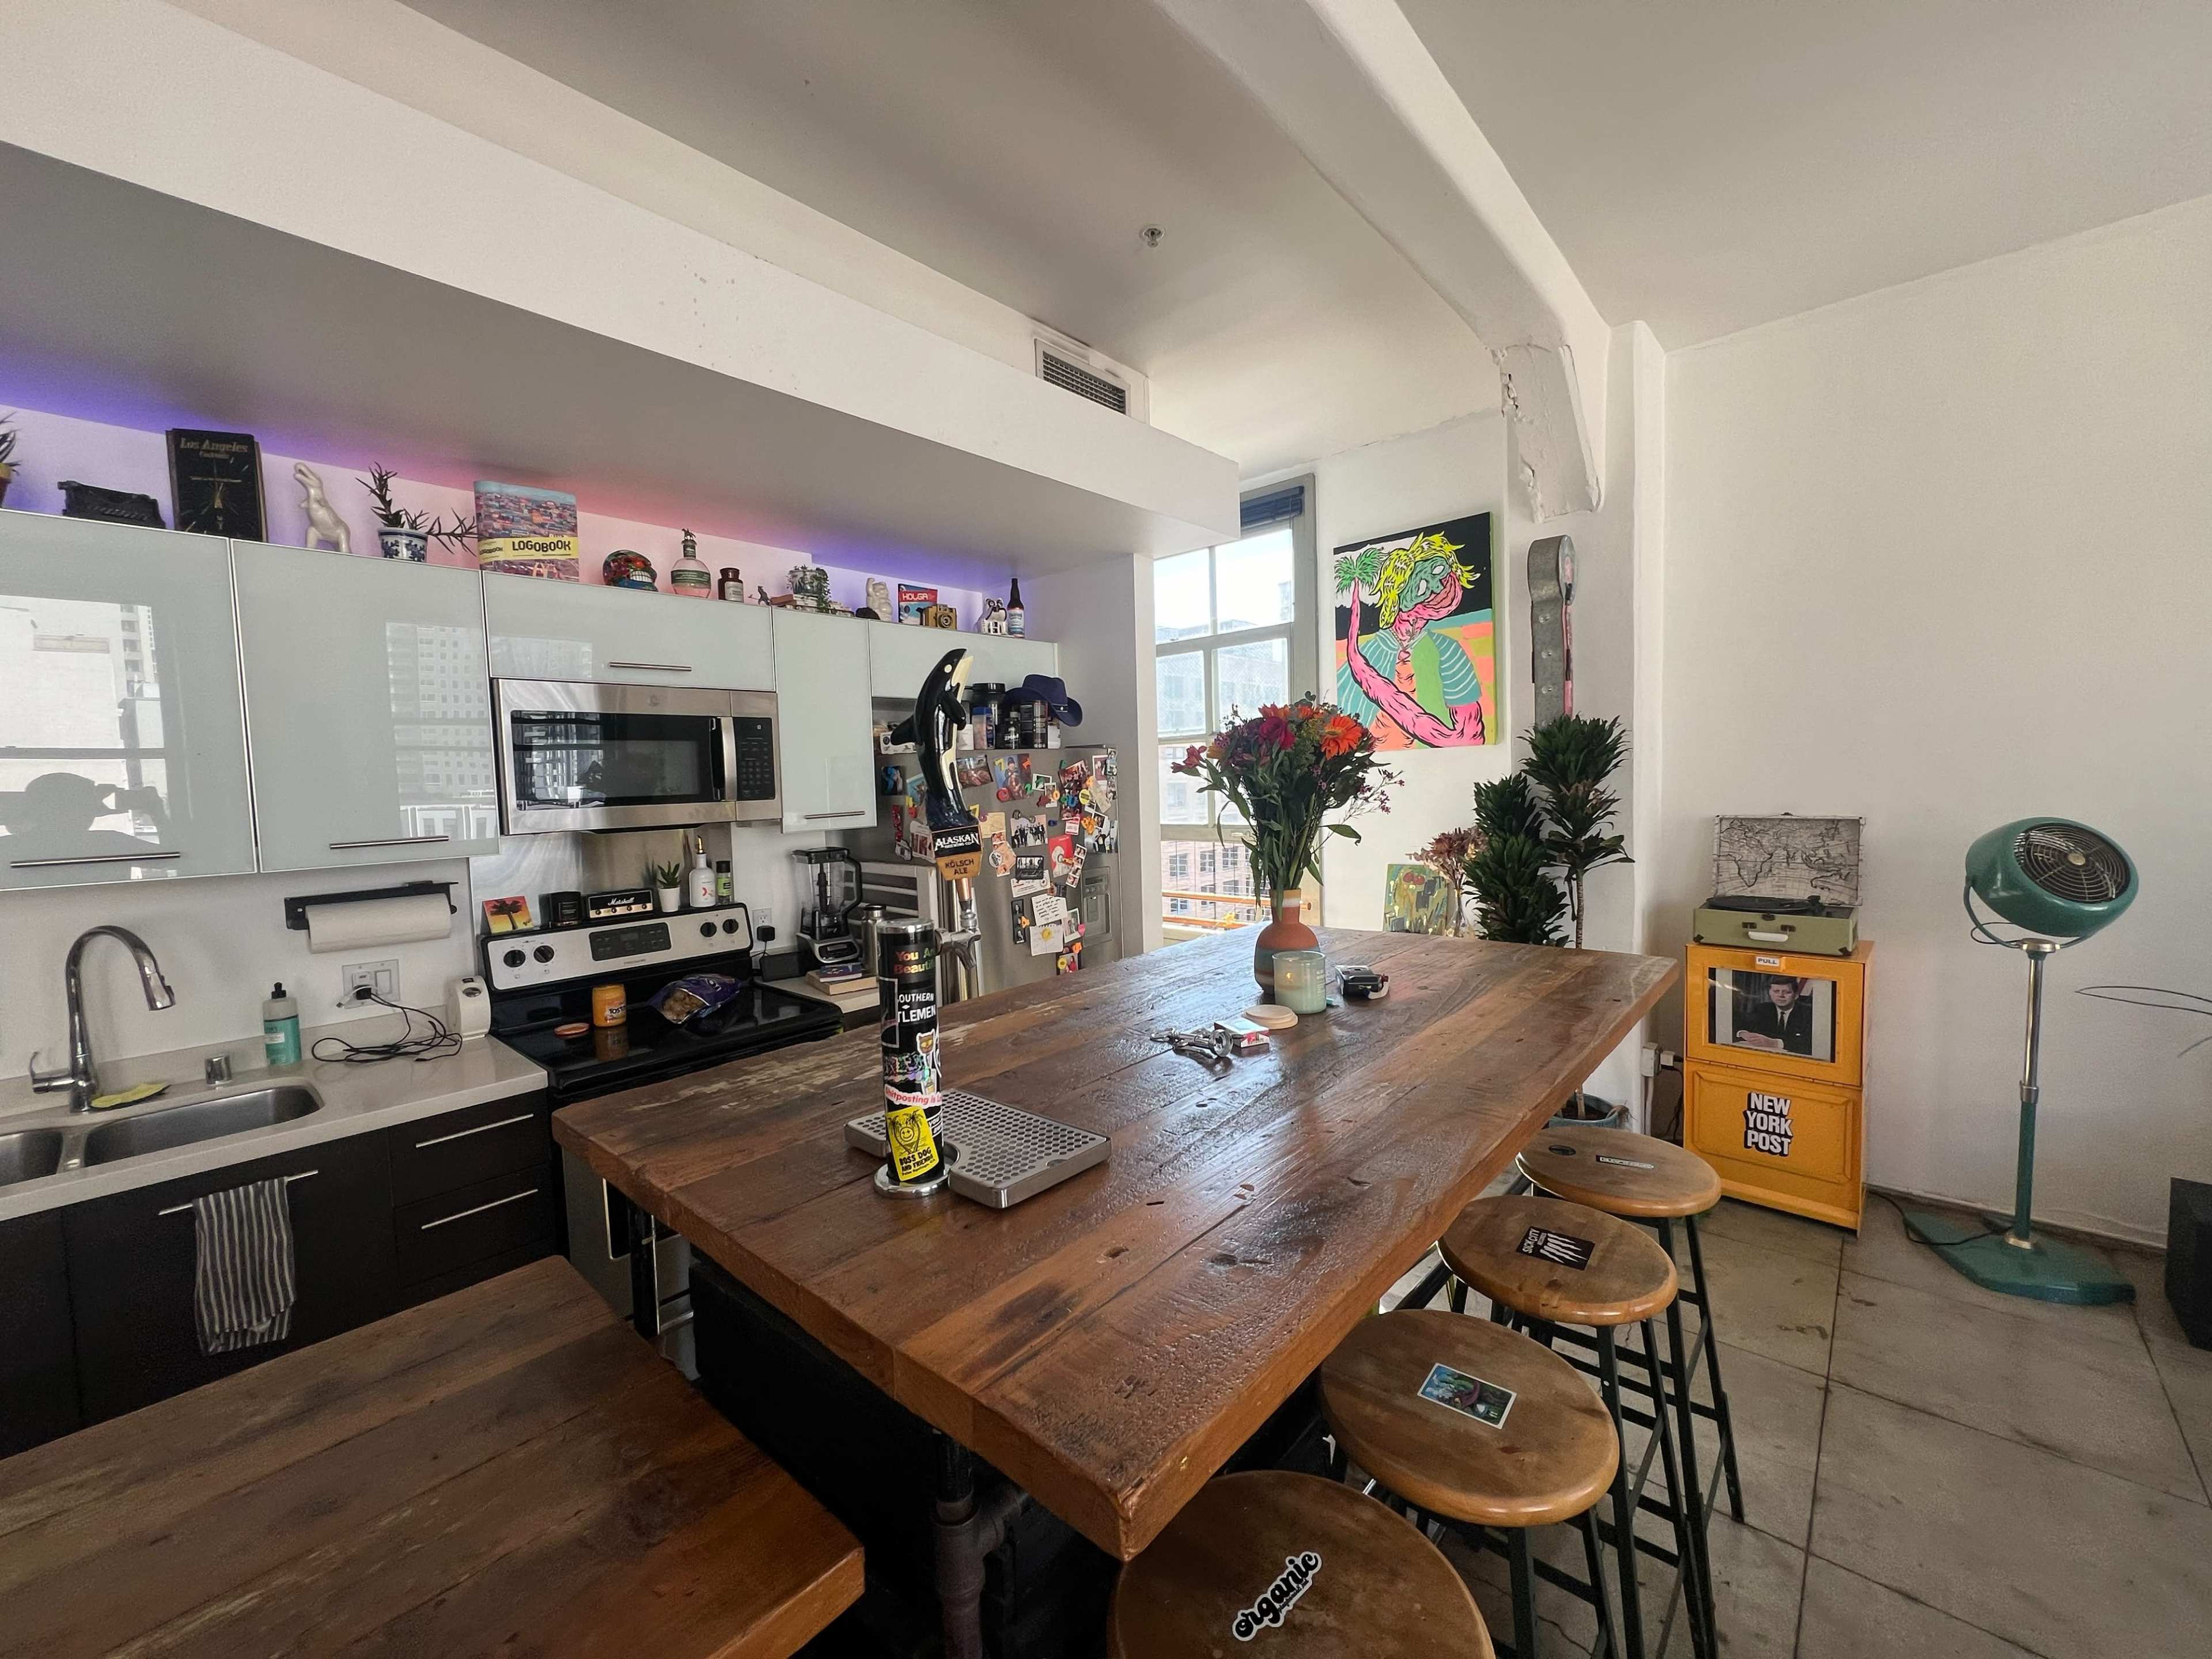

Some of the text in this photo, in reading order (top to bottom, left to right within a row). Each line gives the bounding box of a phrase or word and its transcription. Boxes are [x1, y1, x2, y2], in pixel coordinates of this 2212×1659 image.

[181, 437, 199, 449] Los
[512, 540, 571, 552] LOGOBOOK
[934, 832, 980, 851] ALASKAN
[945, 858, 974, 868] KÖLSCH
[954, 867, 968, 875] ALE
[608, 897, 635, 906] Marshall
[896, 951, 919, 961] You
[897, 993, 934, 1003] OUTHERN
[897, 1004, 935, 1022] TLEMEN
[1749, 1093, 1791, 1115] NEW
[1746, 1111, 1793, 1137] YORK
[1746, 1130, 1791, 1155] POST
[899, 1147, 931, 1165] BOSS DOG
[1522, 1228, 1540, 1253] SICK CITY
[1236, 1554, 1319, 1637] organic
